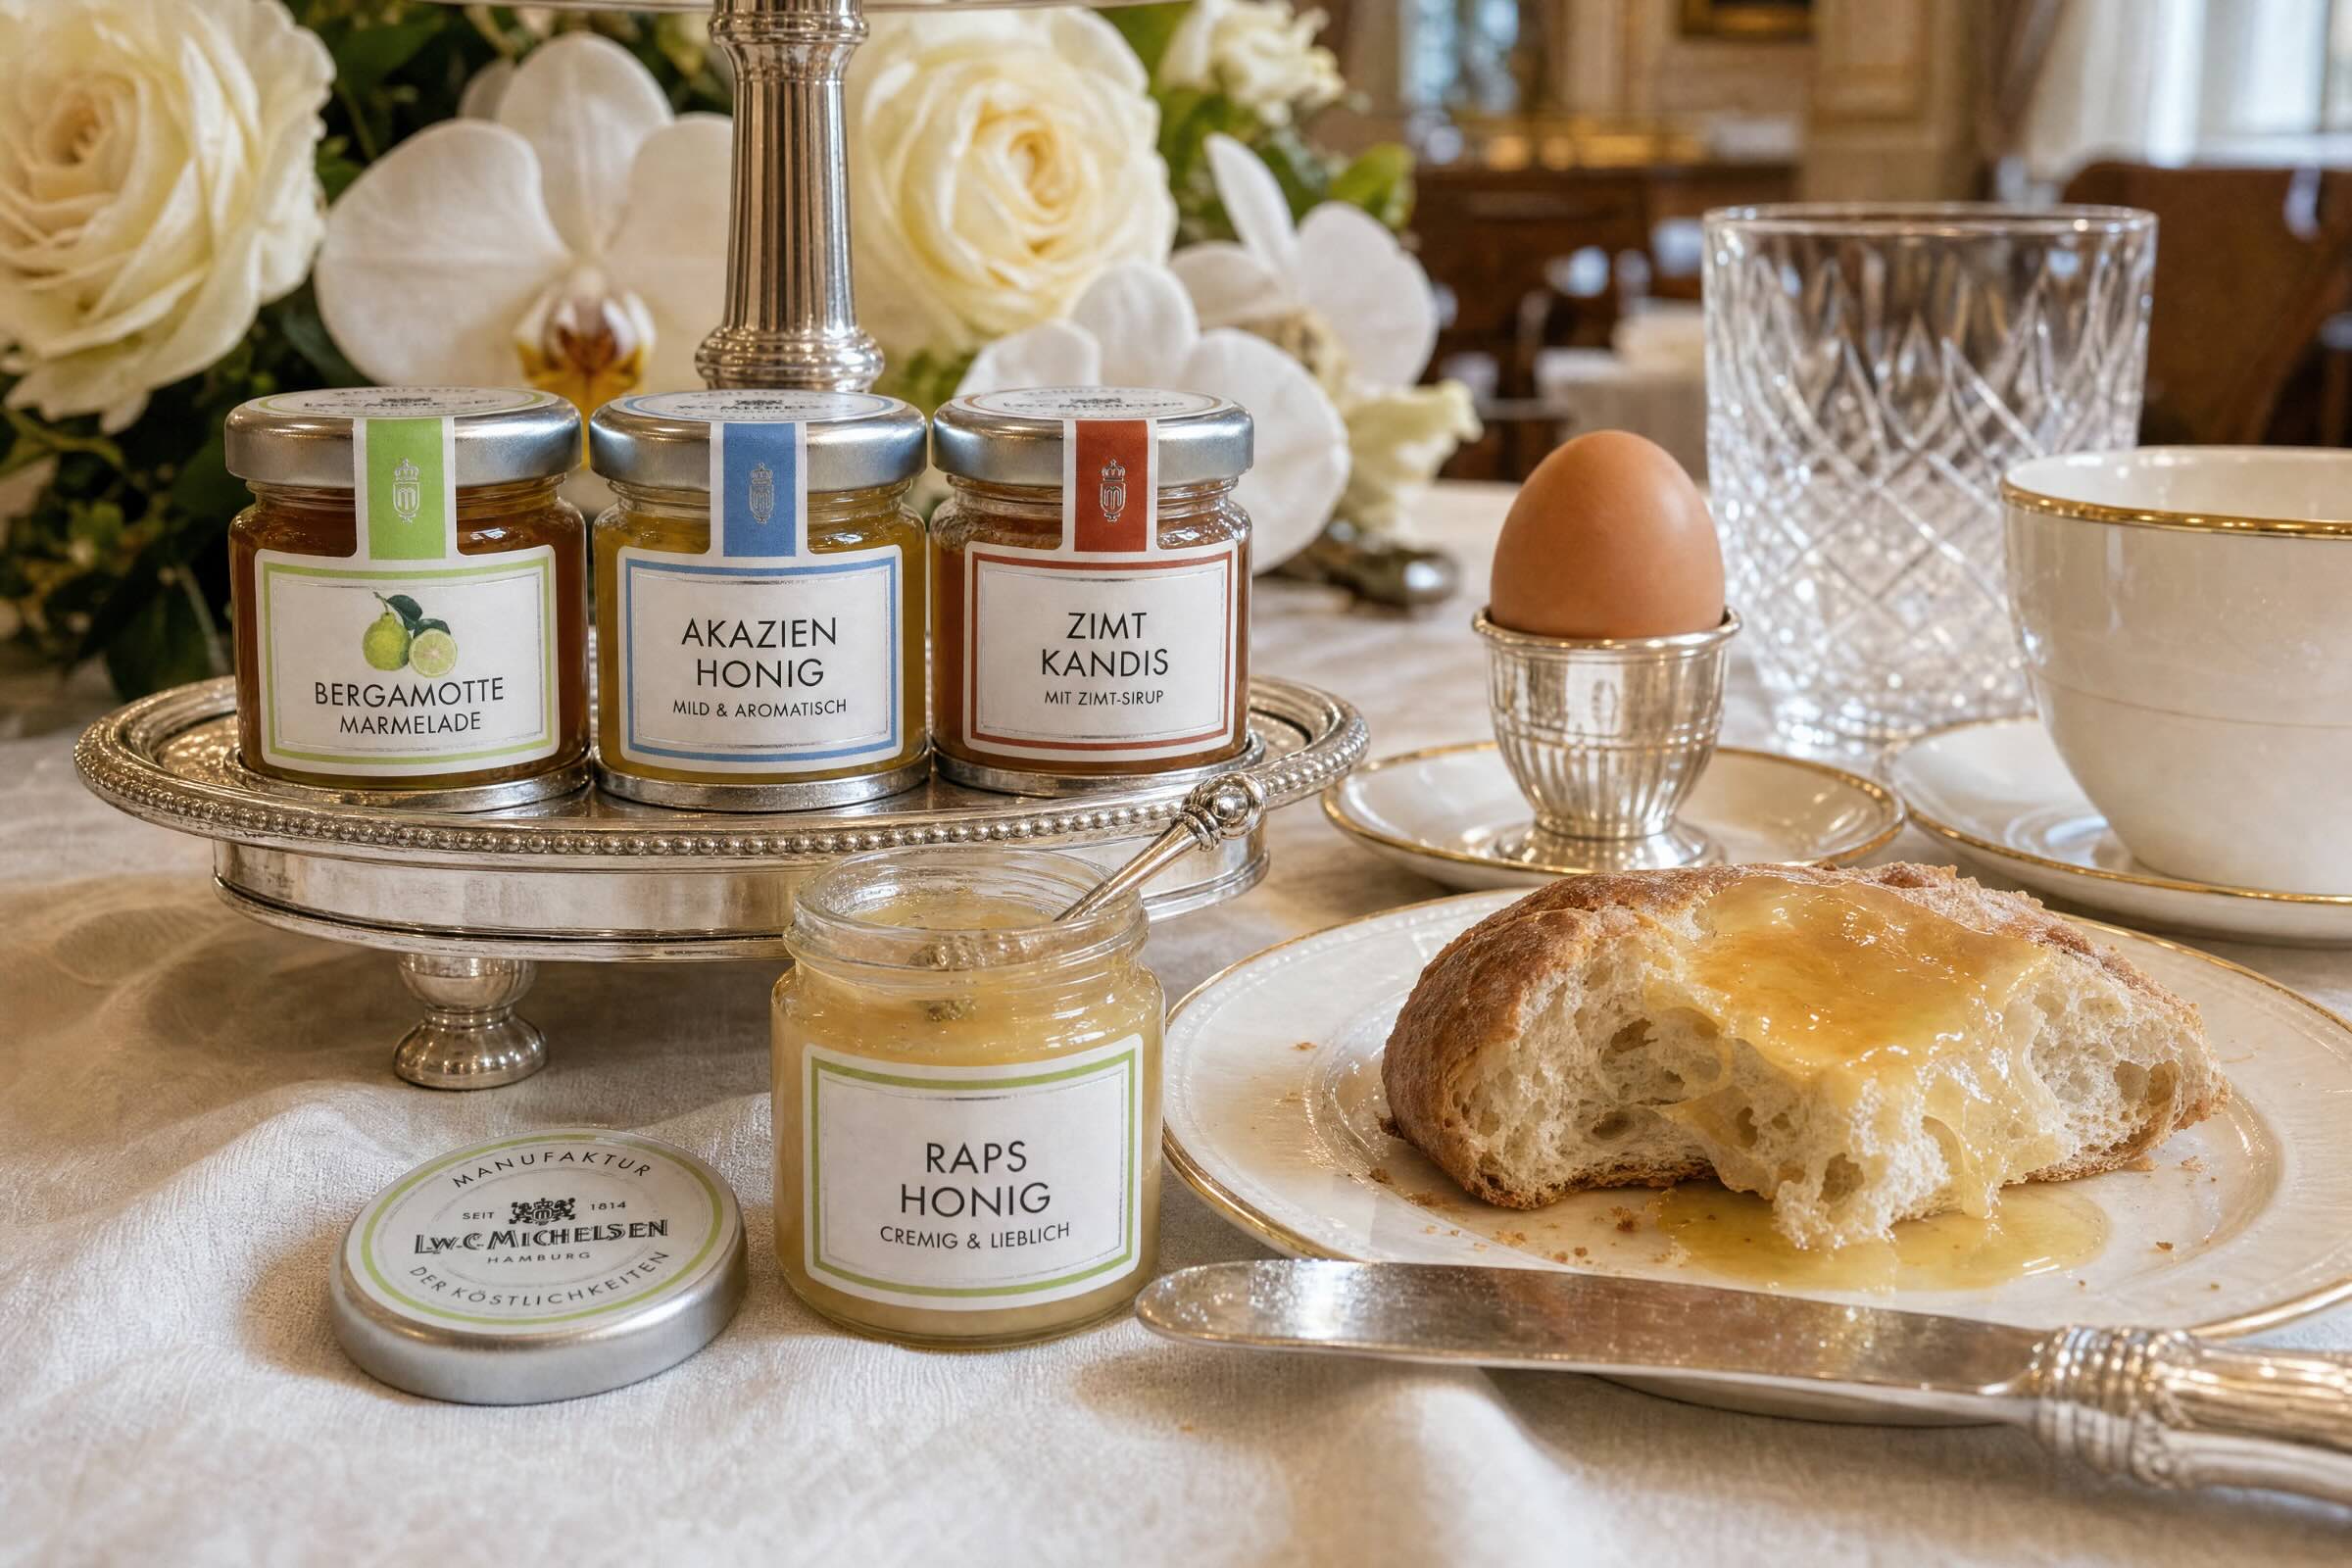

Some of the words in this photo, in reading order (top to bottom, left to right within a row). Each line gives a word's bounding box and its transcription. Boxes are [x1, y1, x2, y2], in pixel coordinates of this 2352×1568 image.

[681, 617, 836, 648] AKAZIEN
[1066, 612, 1147, 640] ZIMT
[698, 659, 823, 688] HONIG
[1043, 649, 1168, 677] KANDIS
[316, 677, 504, 708] BERGAMOTTE
[1045, 691, 1071, 705] MIT
[1078, 690, 1163, 706] ZIMT-SIRUP
[673, 700, 710, 715] MILD
[716, 703, 727, 716] &
[735, 699, 846, 717] AROMATISCH
[340, 711, 480, 734] MARMELADE
[453, 1152, 650, 1188] MANUFAKTUR
[927, 1141, 1026, 1174] RAPS
[592, 1201, 625, 1210] 1814
[902, 1182, 1051, 1217] HONIG
[463, 1211, 494, 1220] SEIT
[880, 1226, 957, 1250] CREMIG
[967, 1233, 980, 1250] &
[991, 1222, 1069, 1249] LIEBLICH
[487, 1252, 590, 1263] HAMBURG
[410, 1266, 446, 1292] DER
[452, 1251, 668, 1305] KÖSTLICHKEITEN
